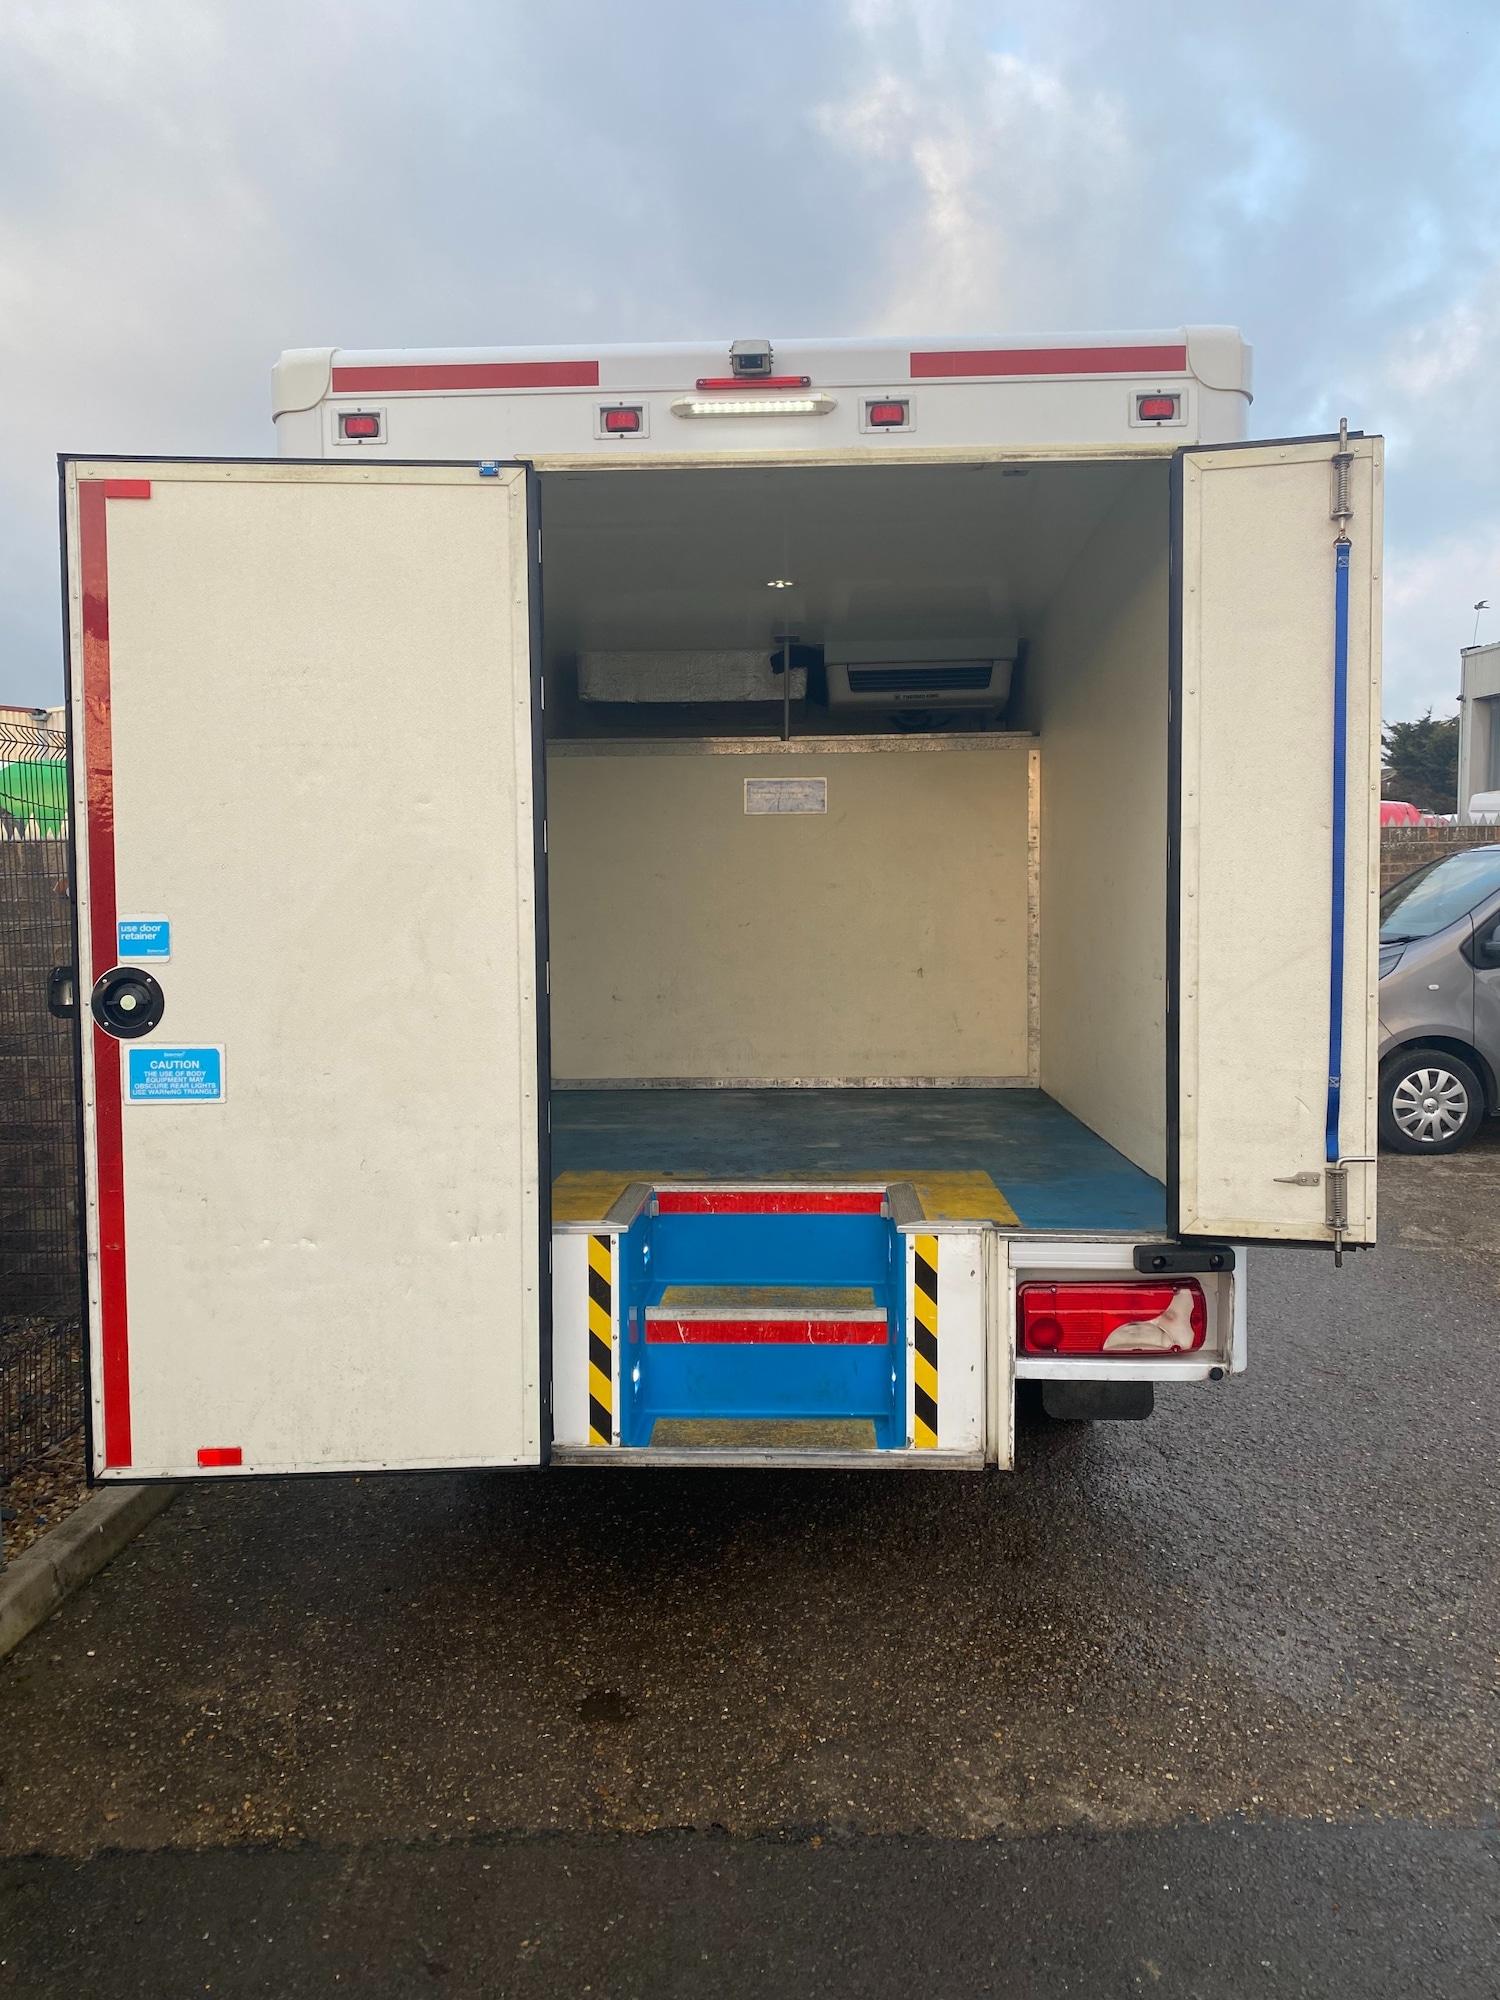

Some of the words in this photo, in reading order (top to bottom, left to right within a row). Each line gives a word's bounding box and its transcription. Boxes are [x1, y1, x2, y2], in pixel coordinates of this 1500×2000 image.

[139, 924, 162, 932] door
[120, 932, 157, 940] retainer
[150, 1060, 200, 1069] CAUTION
